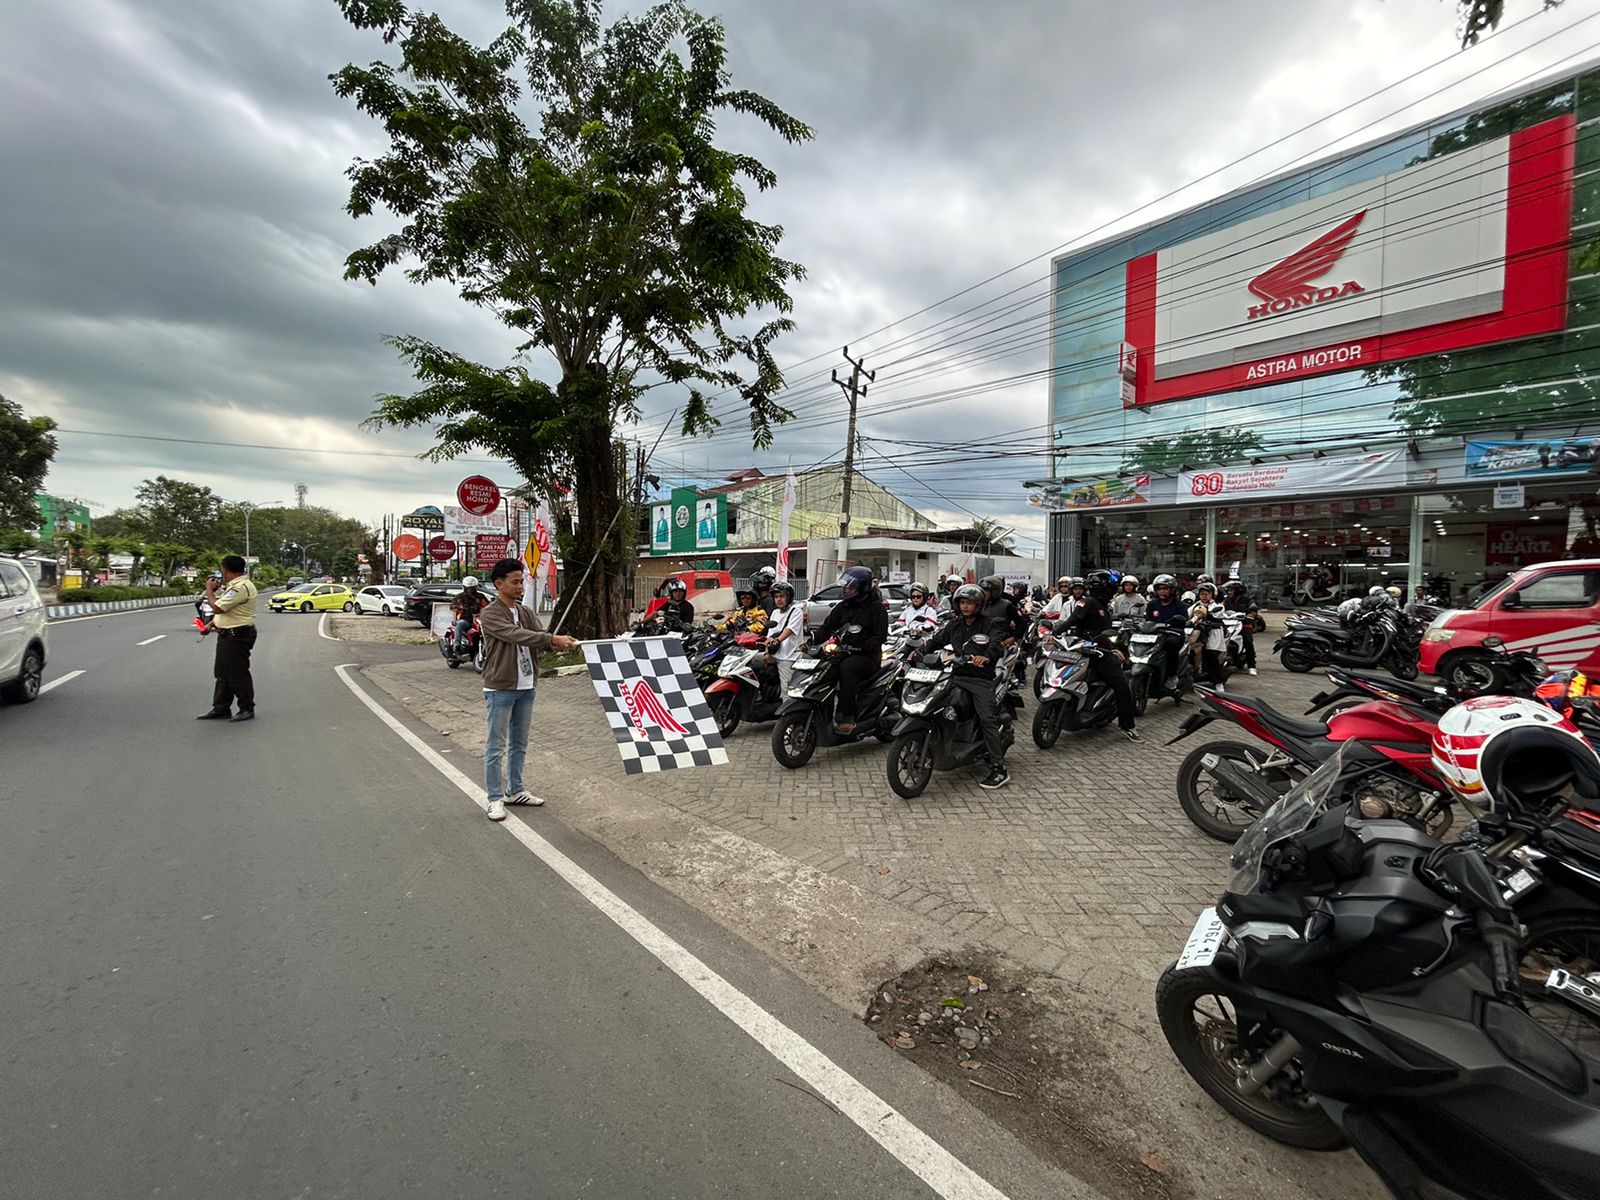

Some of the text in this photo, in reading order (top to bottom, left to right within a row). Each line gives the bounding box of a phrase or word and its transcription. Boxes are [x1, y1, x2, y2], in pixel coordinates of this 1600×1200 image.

[1247, 279, 1366, 320] HONDA
[1247, 345, 1362, 380] ASTRA MOTOR
[464, 483, 497, 493] BENGKEL
[1192, 472, 1224, 496] 80
[466, 495, 494, 504] HONDA
[403, 517, 444, 525] ROYAL
[618, 683, 648, 738] HONDA
